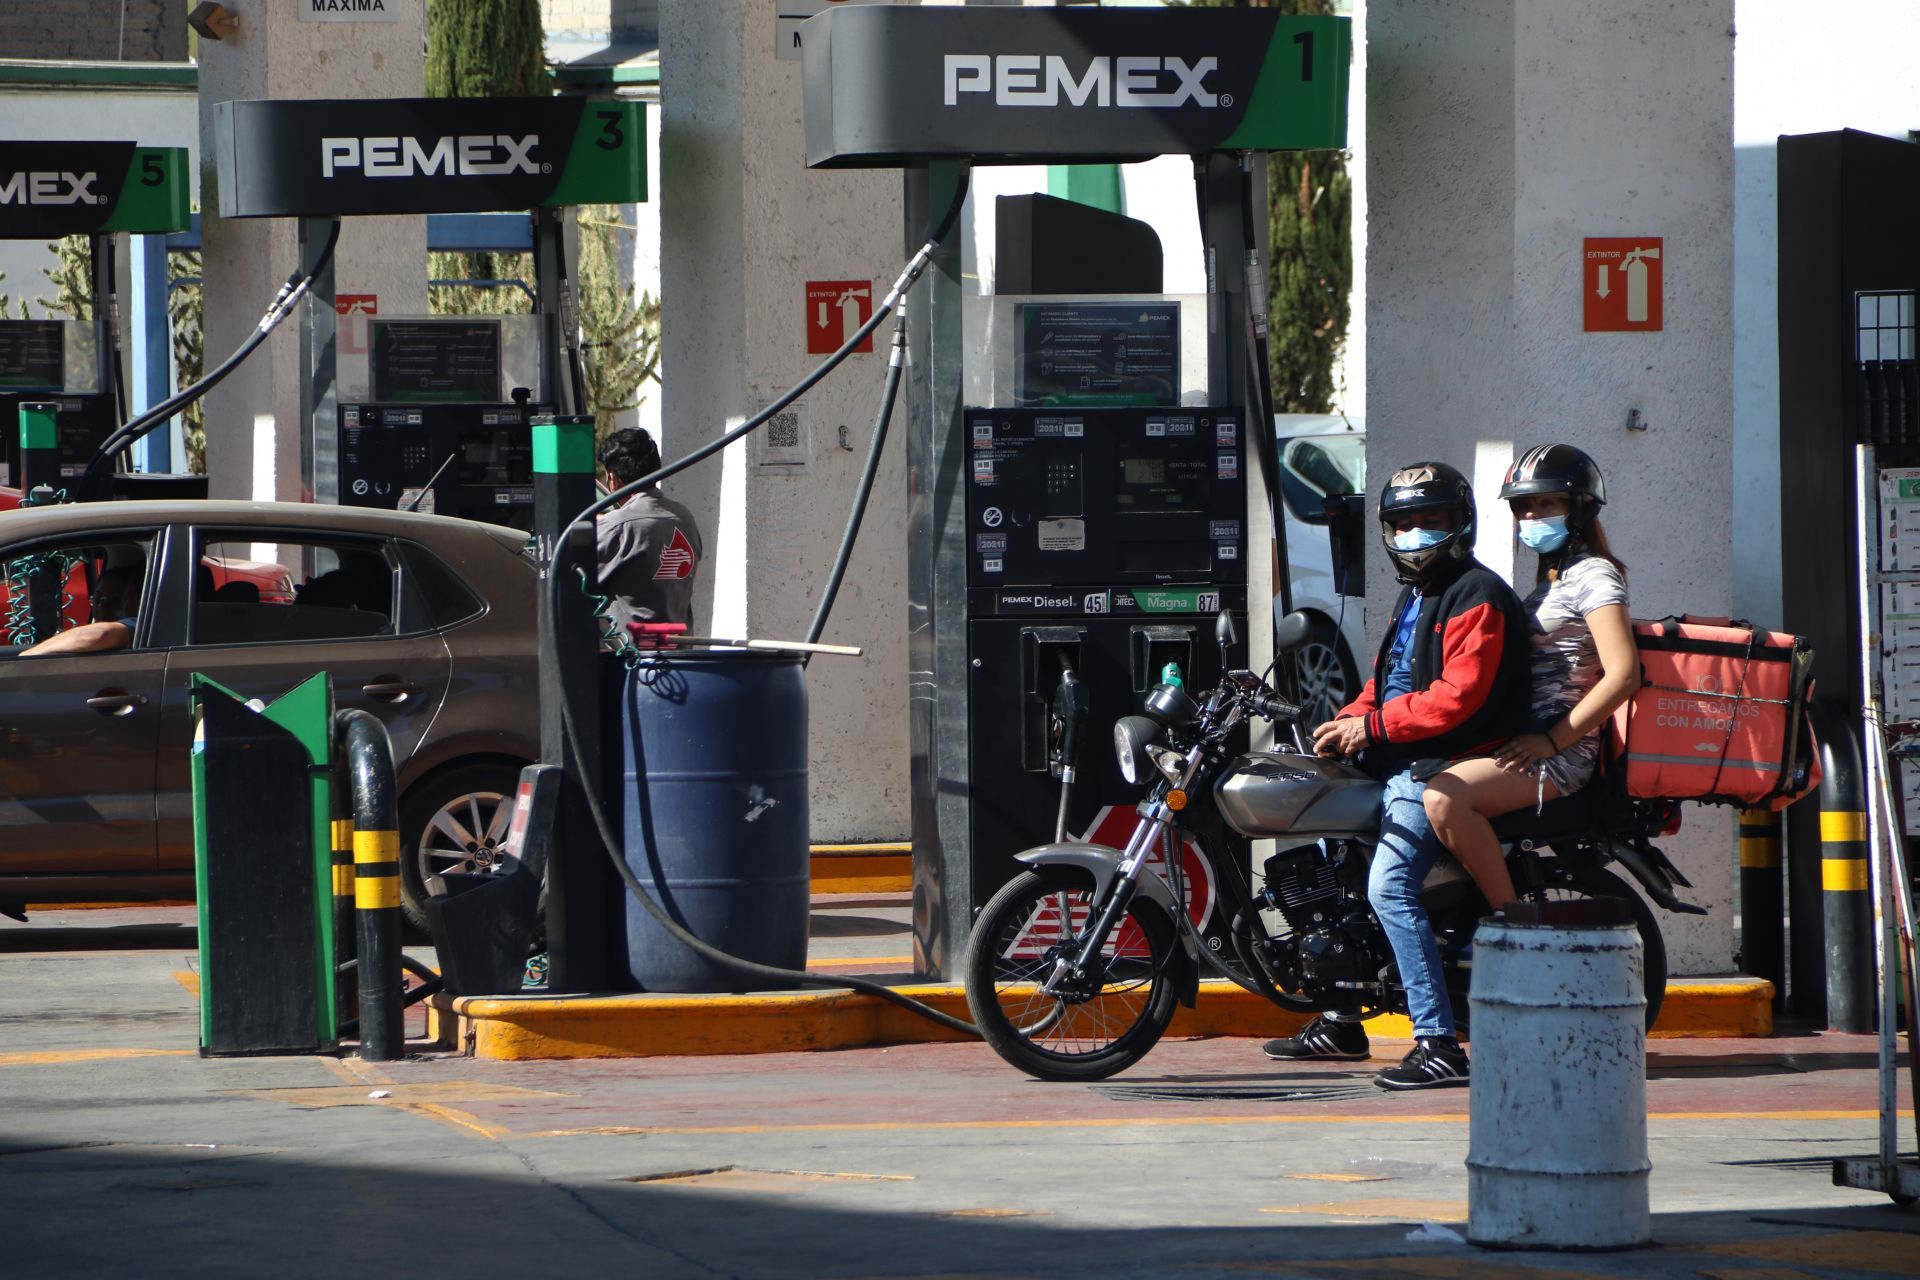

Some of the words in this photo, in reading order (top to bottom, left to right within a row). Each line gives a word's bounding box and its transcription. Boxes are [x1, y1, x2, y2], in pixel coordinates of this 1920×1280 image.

[312, 0, 385, 12] MAXIMA
[1293, 31, 1315, 82] 1
[595, 110, 625, 150] 3
[141, 154, 165, 187] 5
[1587, 251, 1621, 259] EXTINTOR
[1002, 596, 1033, 604] PEMEX
[1034, 595, 1073, 608] Diesel
[1085, 595, 1102, 612] 45
[1147, 596, 1188, 611] Magna
[1198, 594, 1214, 612] 87
[1657, 697, 1761, 718] ENTREGAMOS
[1656, 714, 1689, 728] CON
